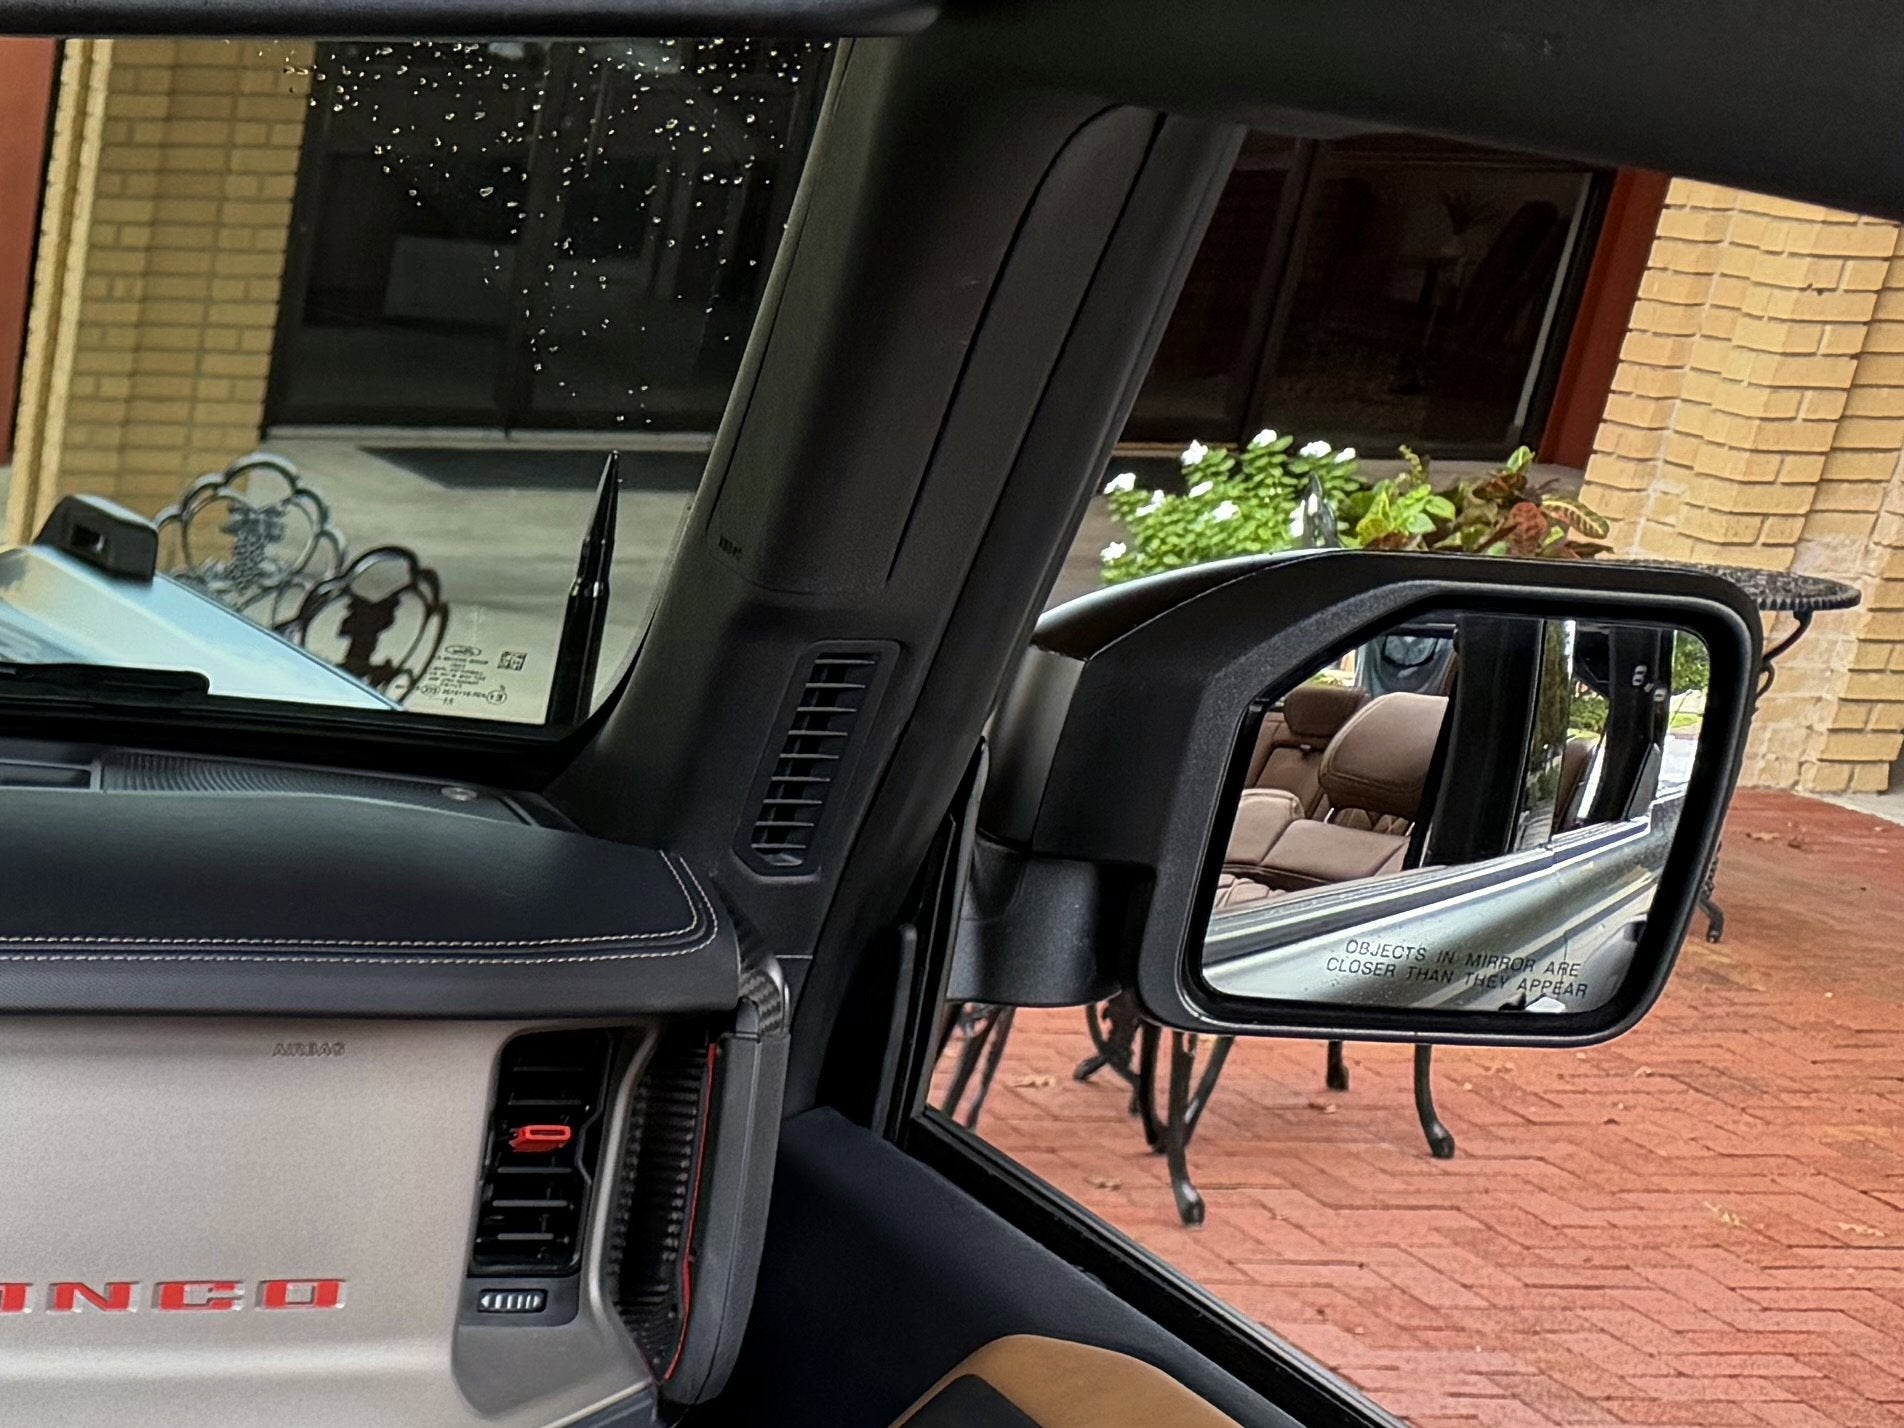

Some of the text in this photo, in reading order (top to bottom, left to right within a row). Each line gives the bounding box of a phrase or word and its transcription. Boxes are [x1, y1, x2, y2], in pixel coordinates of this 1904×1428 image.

[1326, 956, 1589, 1000] CLOSER THAN THEY APPEAR
[1345, 939, 1582, 978] OBJECTS IN MIRROR ARE
